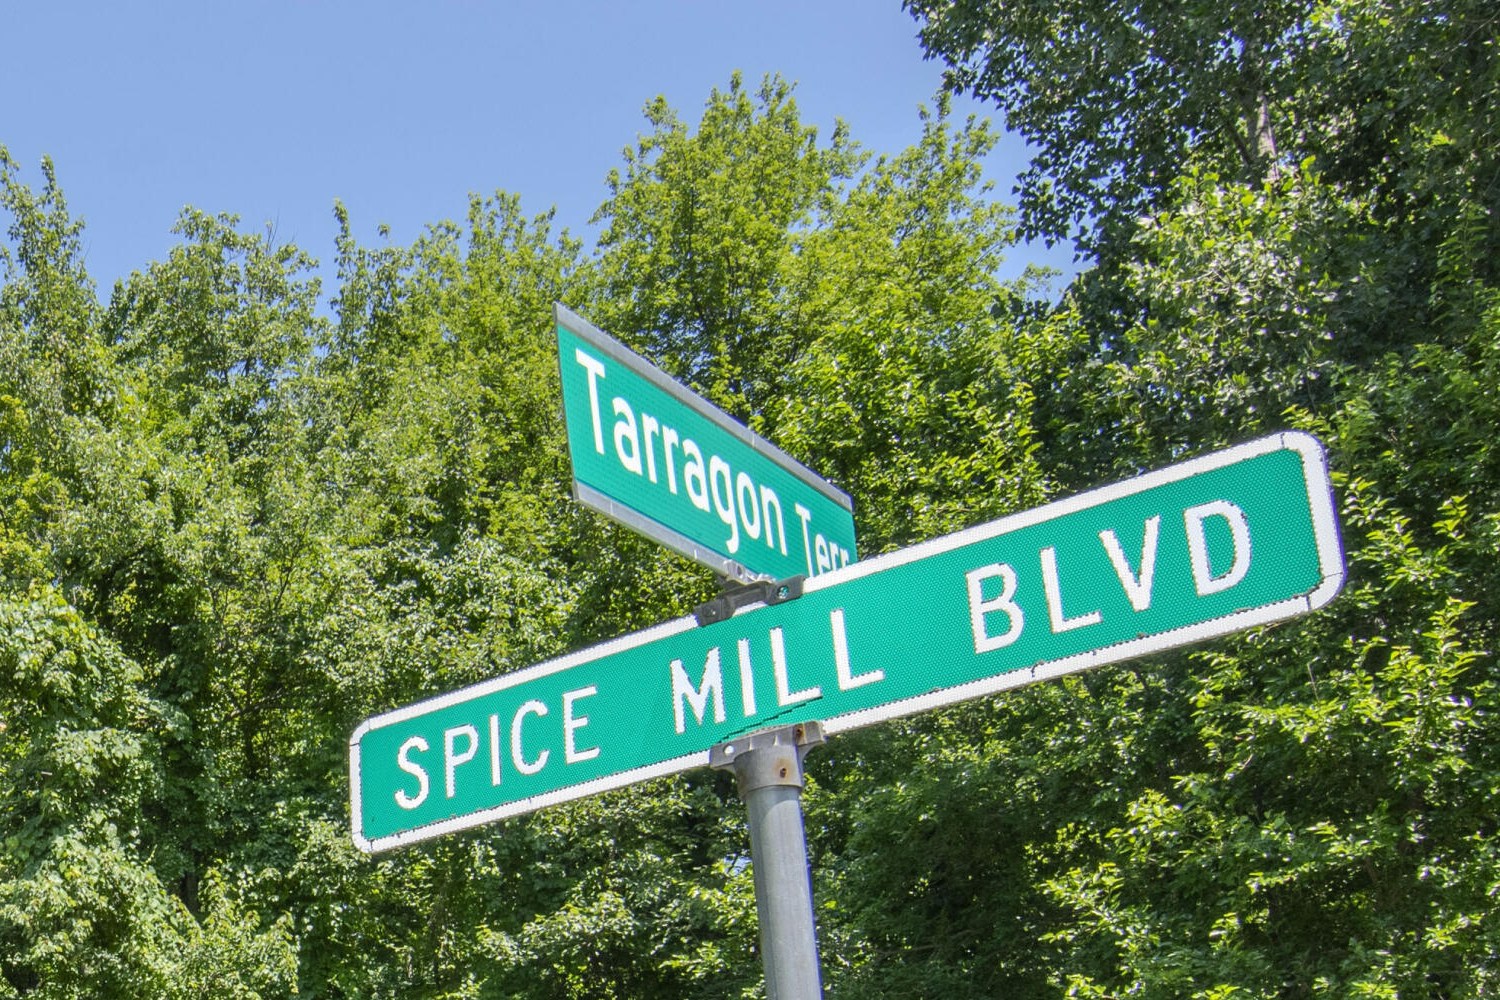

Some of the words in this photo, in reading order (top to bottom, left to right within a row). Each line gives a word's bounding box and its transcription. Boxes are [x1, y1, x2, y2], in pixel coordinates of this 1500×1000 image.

[575, 348, 788, 554] Tarragon
[394, 685, 601, 811] SPICE
[671, 608, 885, 734] MILL
[967, 498, 1252, 654] BLVD
